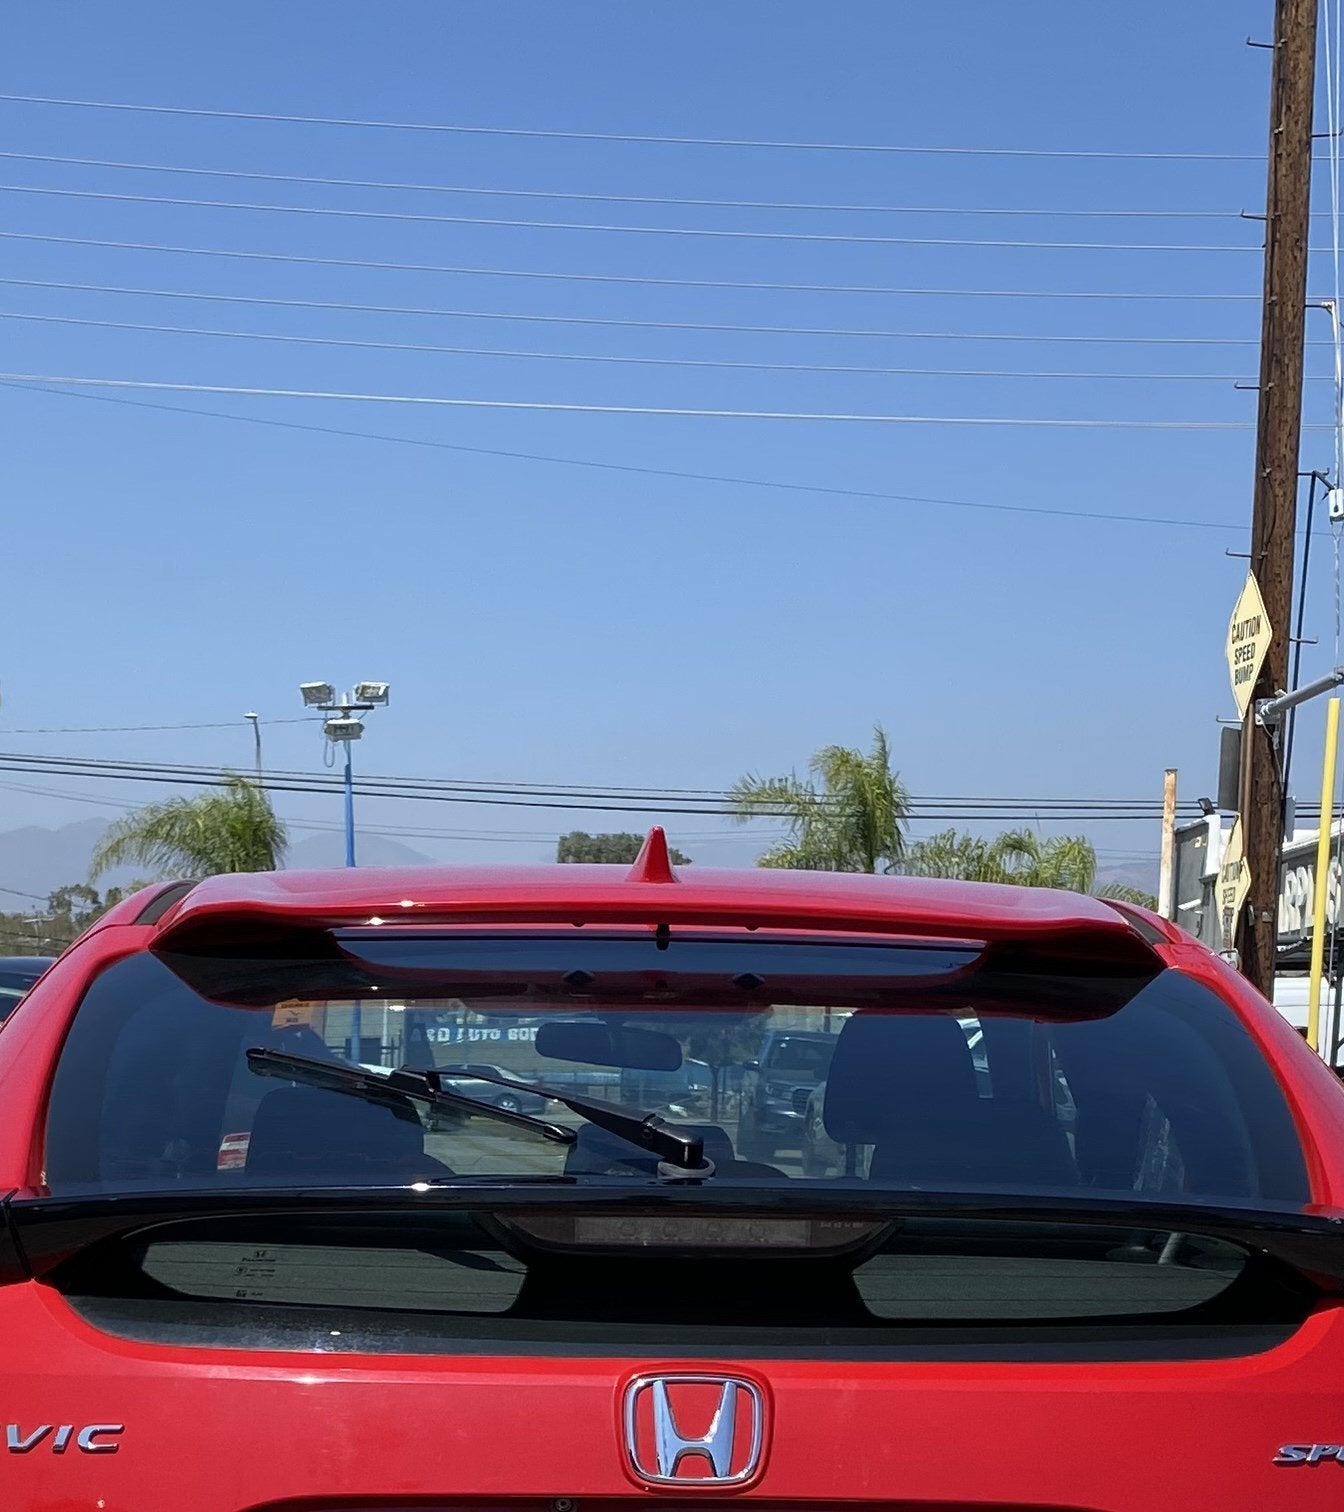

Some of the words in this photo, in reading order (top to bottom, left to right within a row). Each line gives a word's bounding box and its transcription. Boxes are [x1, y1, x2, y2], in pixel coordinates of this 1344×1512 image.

[1232, 615, 1262, 645] CAUTION
[1234, 642, 1256, 666] SPEED
[1235, 663, 1254, 686] BUMP
[508, 1027, 541, 1042] BOD
